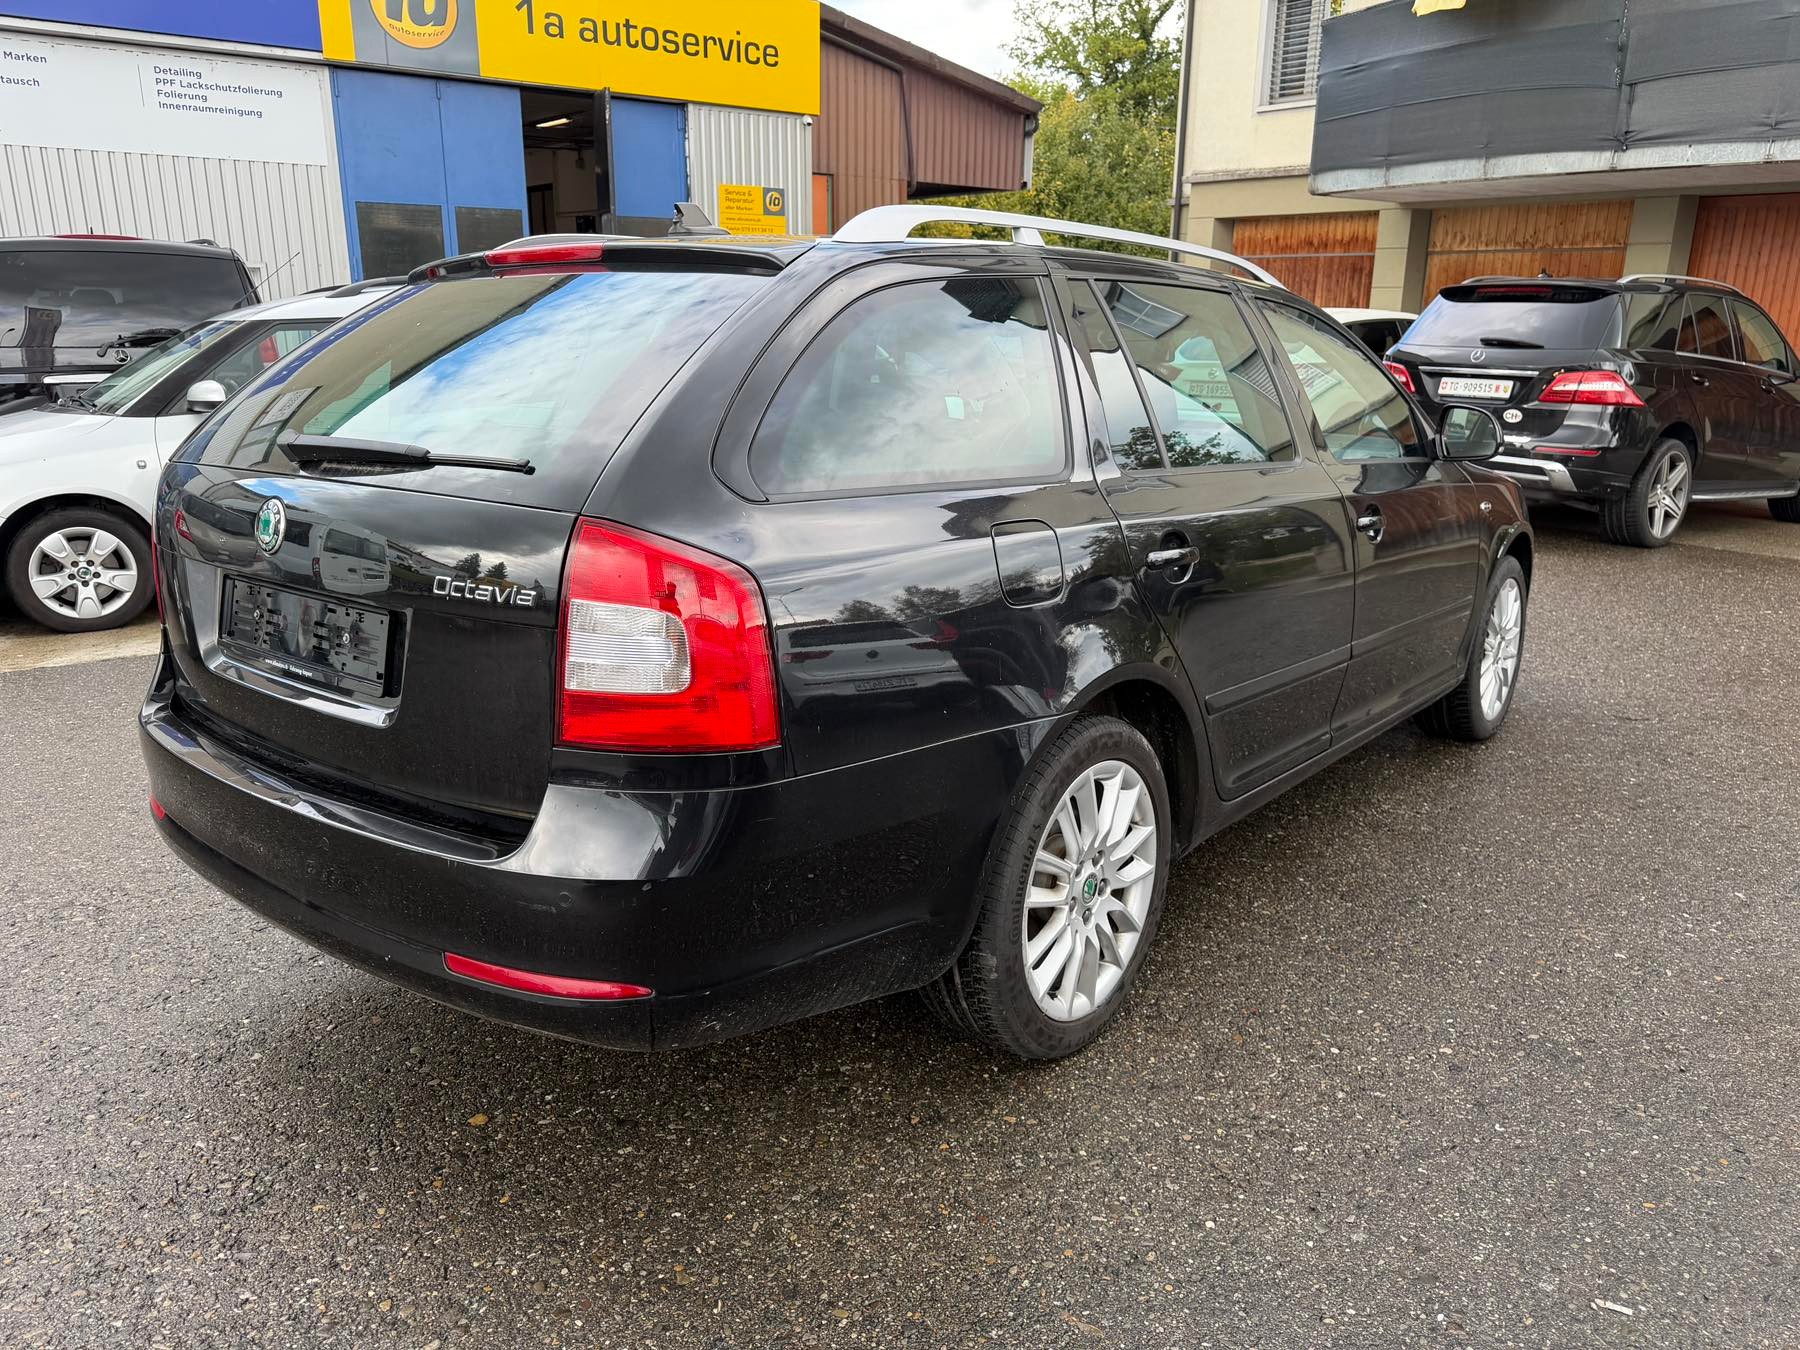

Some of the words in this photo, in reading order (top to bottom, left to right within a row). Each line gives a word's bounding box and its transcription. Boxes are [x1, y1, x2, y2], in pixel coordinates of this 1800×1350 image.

[389, 22, 446, 39] autoservice
[513, 0, 565, 39] 1a
[578, 18, 780, 68] autoservice
[3, 51, 47, 63] Marken
[153, 65, 203, 80] Detailing
[155, 78, 177, 88] PPF
[179, 80, 284, 98] Lackschutzfolierung
[157, 89, 208, 103] Folierung
[158, 101, 263, 118] Innenraumreinigung
[725, 189, 746, 197] Service
[725, 196, 755, 204] Reparatur
[1504, 412, 1518, 420] CH
[433, 576, 536, 606] Octavia
